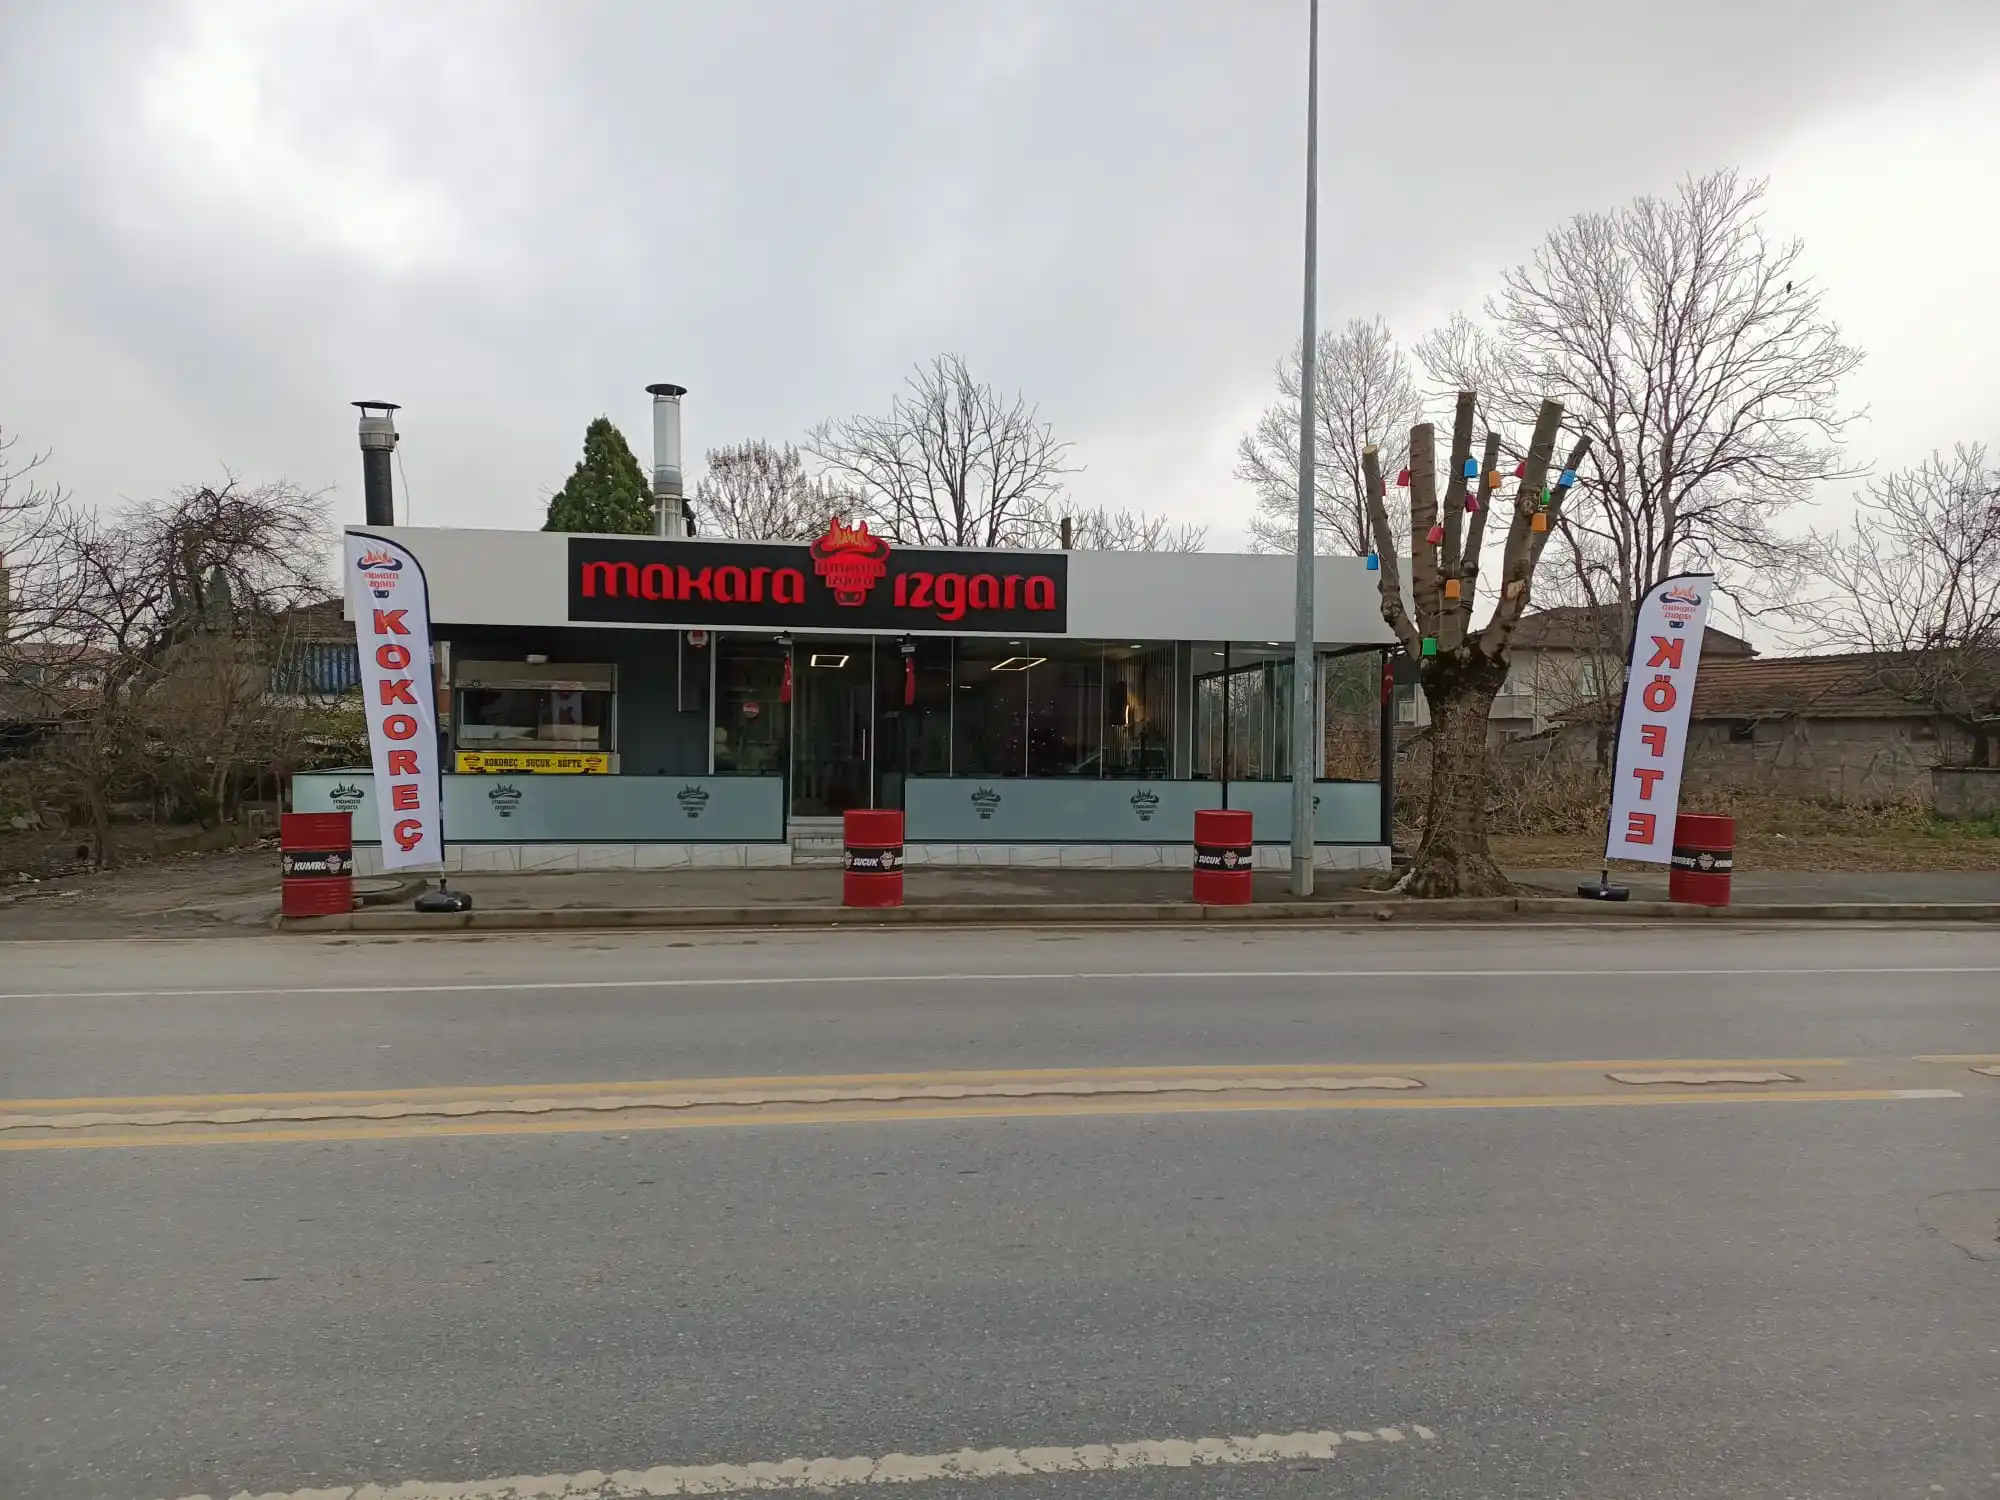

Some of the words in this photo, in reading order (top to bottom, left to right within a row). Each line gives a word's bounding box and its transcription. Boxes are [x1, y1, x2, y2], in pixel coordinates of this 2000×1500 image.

[582, 561, 805, 604] makara
[372, 608, 423, 851] KOKOREÇ
[853, 857, 879, 867] SUCUK
